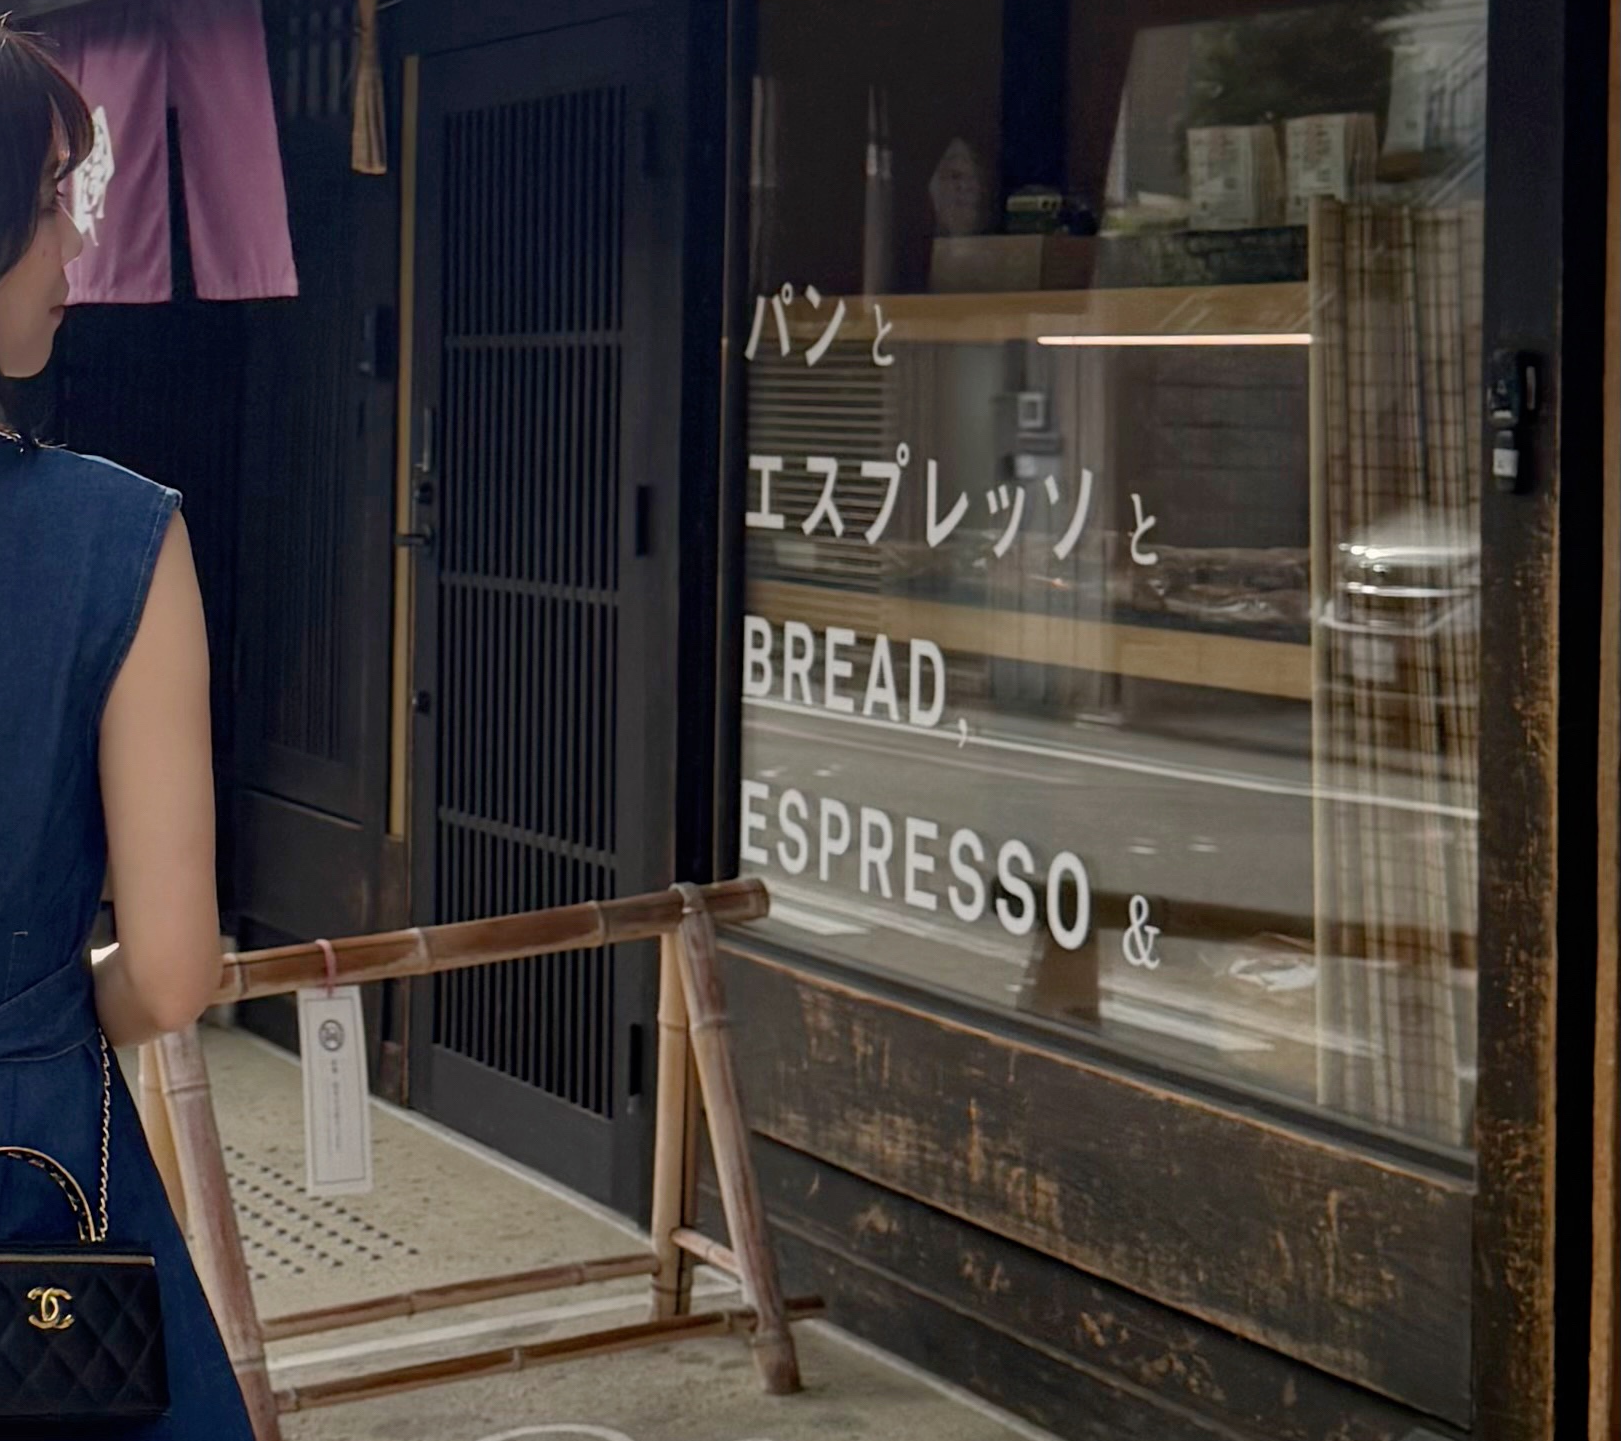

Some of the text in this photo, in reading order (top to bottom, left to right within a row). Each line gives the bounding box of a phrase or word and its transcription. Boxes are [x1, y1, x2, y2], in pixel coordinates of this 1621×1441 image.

[742, 615, 969, 749] BREAD,
[740, 779, 1161, 970] ESPRESSO &
